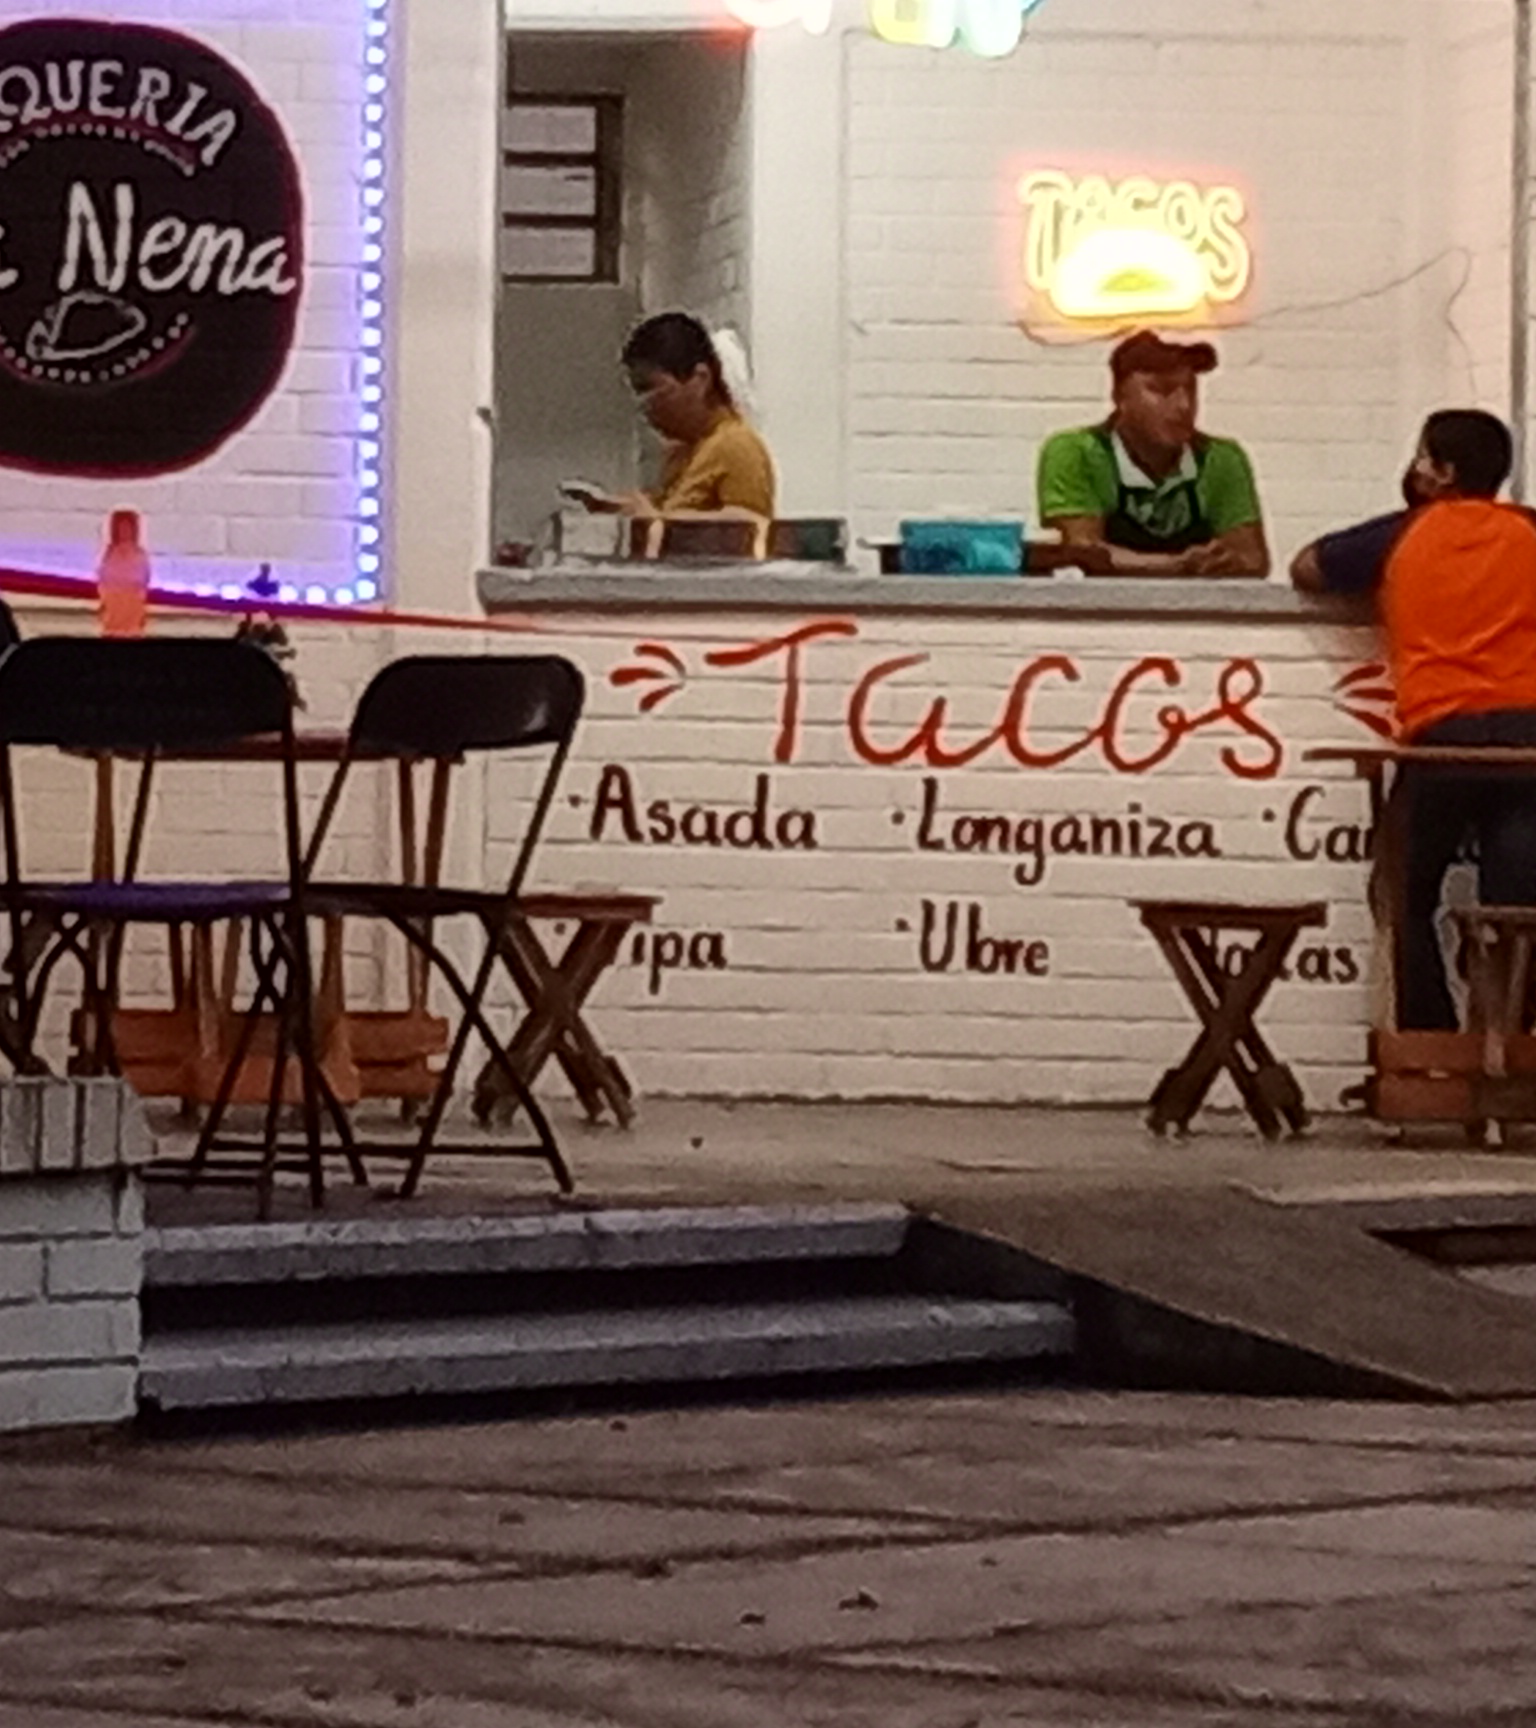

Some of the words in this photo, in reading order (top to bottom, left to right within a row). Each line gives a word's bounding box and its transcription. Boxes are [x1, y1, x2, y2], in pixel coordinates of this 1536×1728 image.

[1017, 169, 1251, 302] TACOS
[590, 763, 818, 850] Asada
[917, 776, 1222, 886] Longaniza
[920, 898, 1050, 976] Ubre
